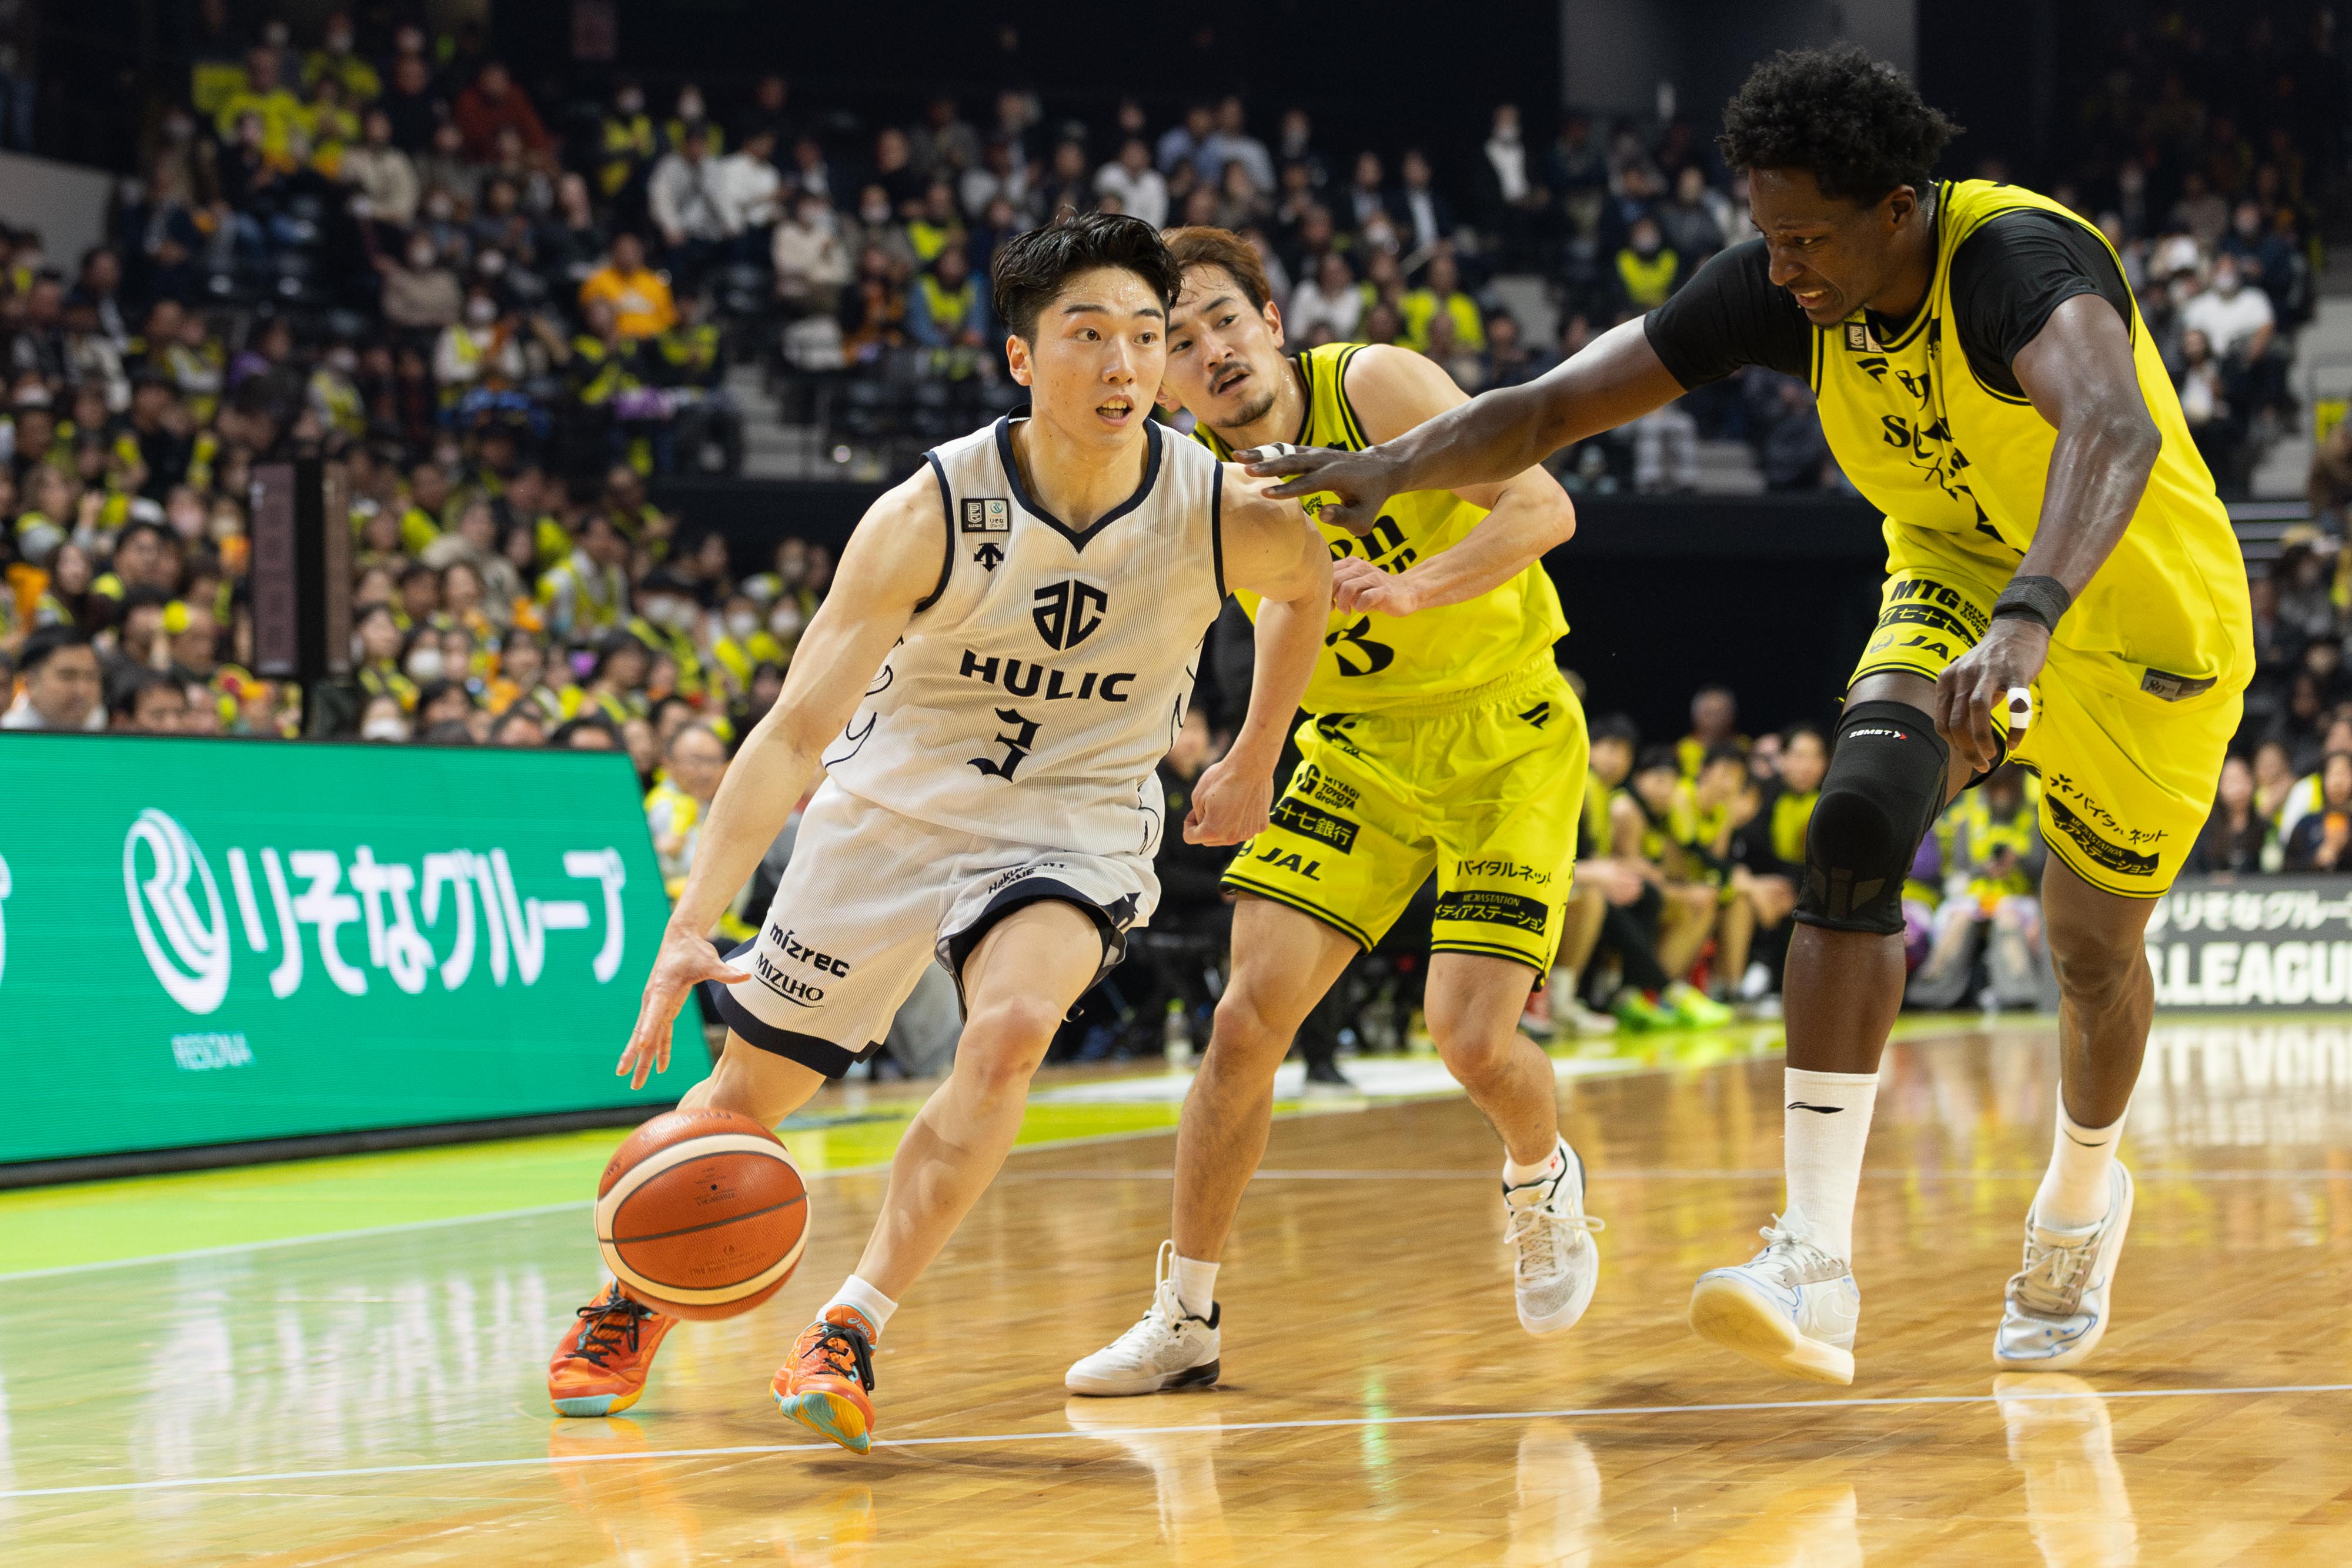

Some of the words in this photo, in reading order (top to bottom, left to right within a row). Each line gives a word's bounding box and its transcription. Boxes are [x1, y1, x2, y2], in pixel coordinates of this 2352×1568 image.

[1890, 579, 1961, 610] MTG
[1965, 600, 1991, 628] MIYA
[1898, 608, 1972, 648] 七十七
[960, 649, 1137, 702] HULIC
[967, 708, 1043, 783] 3
[1315, 791, 1342, 809] Group
[1270, 803, 1352, 846] 十七銀行
[1256, 847, 1321, 881] JAL
[227, 845, 626, 999] りそなグループ
[2173, 890, 2352, 931] りそなグルー
[756, 951, 824, 1001] MIZUHO
[2146, 940, 2352, 1007] .LEAGU
